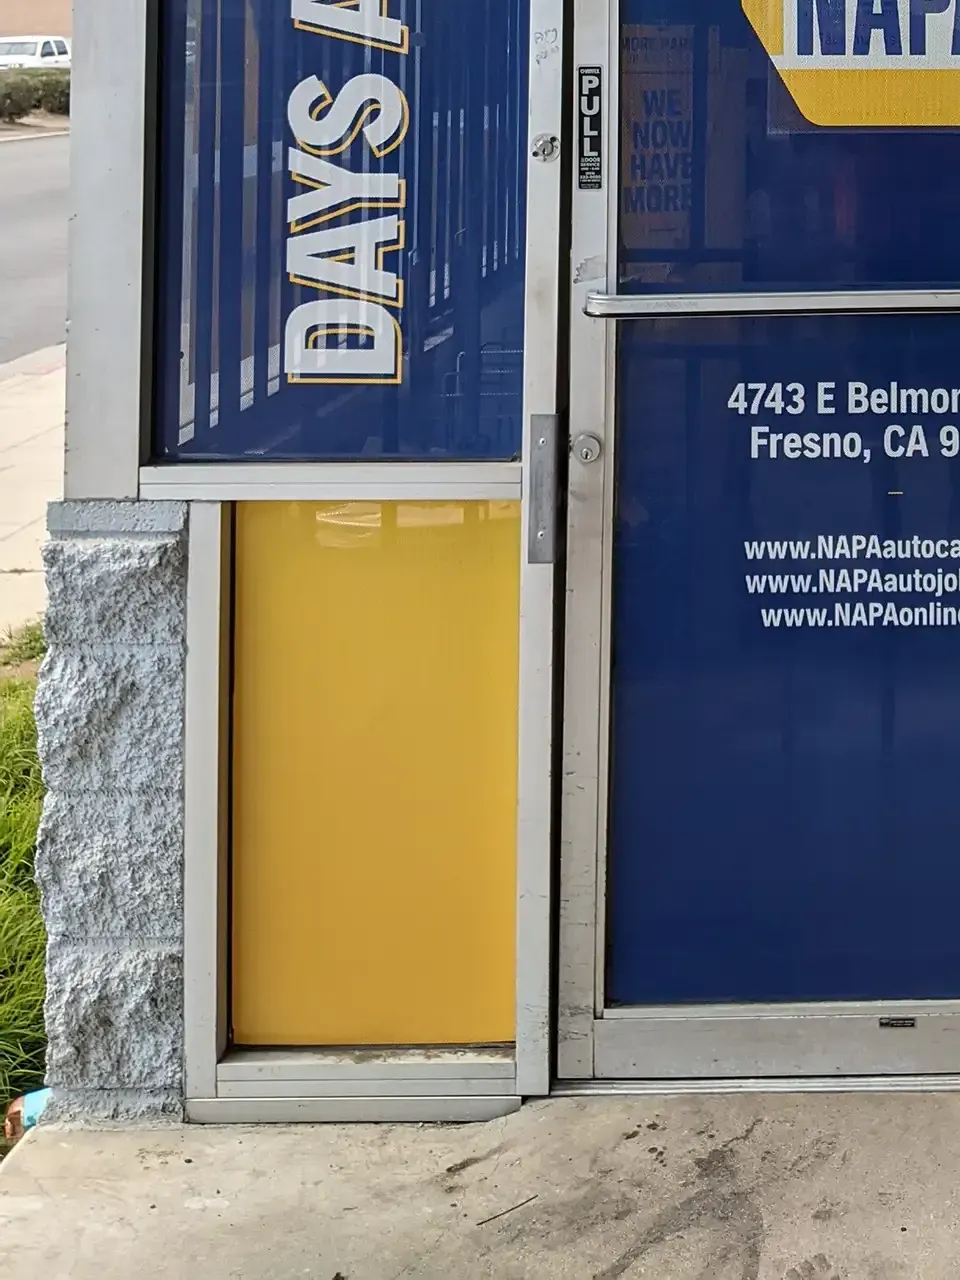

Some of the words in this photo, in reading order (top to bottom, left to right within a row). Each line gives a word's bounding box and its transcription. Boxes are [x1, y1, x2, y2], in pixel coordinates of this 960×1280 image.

[581, 75, 600, 157] PULL
[643, 89, 683, 117] WE
[631, 120, 691, 150] NOW
[284, 72, 410, 385] DAYS
[727, 381, 805, 415] 4743
[816, 381, 836, 414] E
[750, 425, 871, 463] Fresno,
[883, 424, 930, 459] CA
